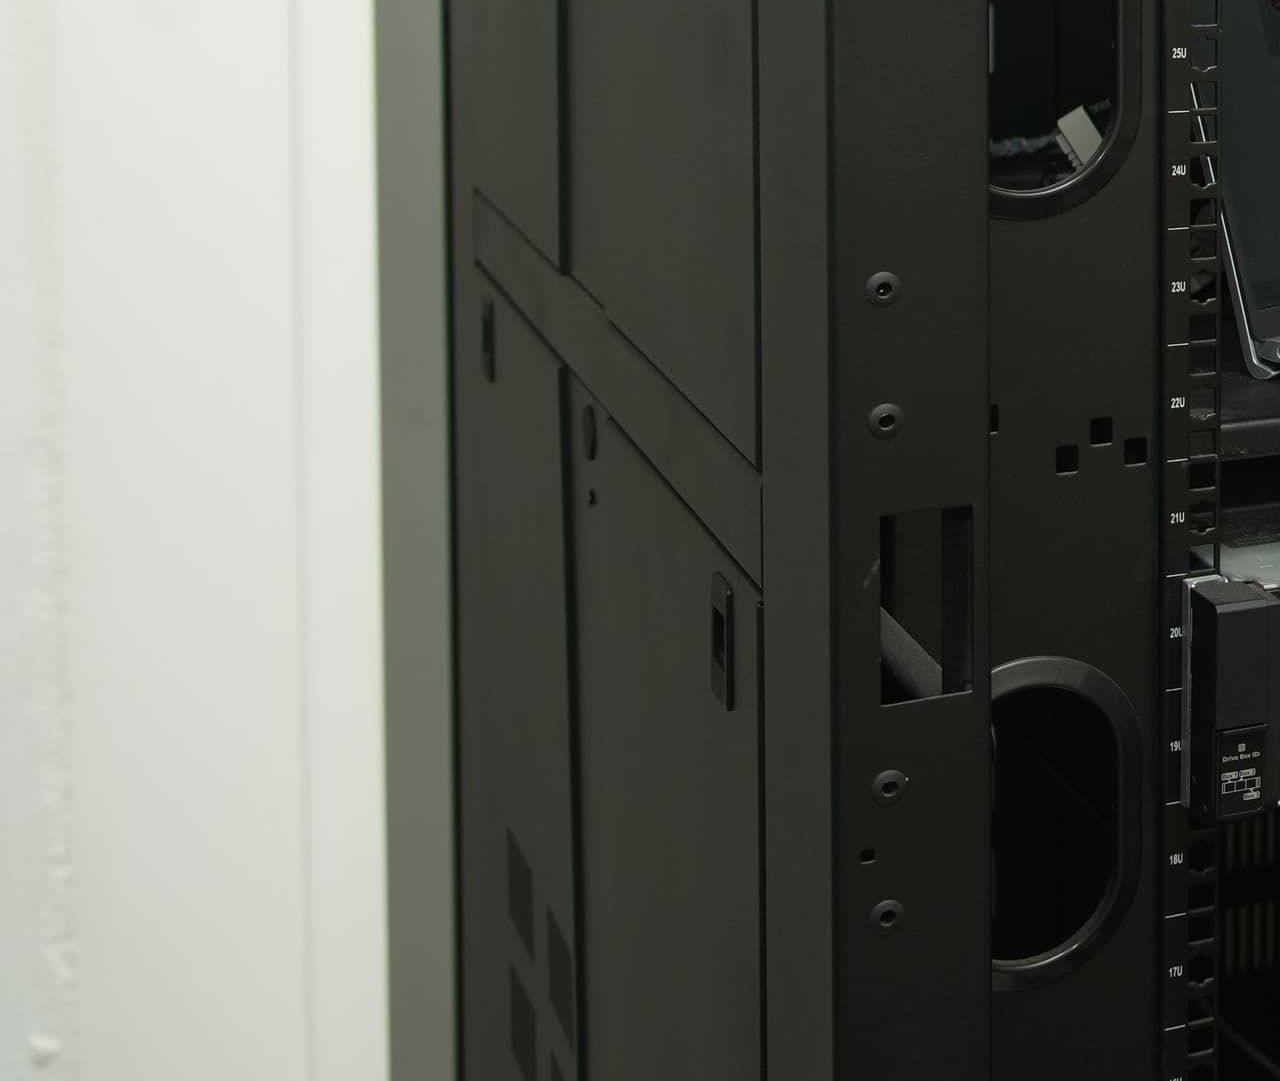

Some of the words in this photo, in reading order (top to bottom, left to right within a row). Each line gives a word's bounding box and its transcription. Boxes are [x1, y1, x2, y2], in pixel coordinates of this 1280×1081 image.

[1173, 47, 1187, 58] 25U
[1172, 165, 1186, 176] 24U
[1172, 281, 1185, 292] 23U
[1171, 397, 1185, 408] 22U
[1171, 512, 1184, 523] 21U
[1222, 755, 1239, 763] Drive
[1169, 853, 1183, 864] 18U
[1169, 966, 1182, 977] 17U
